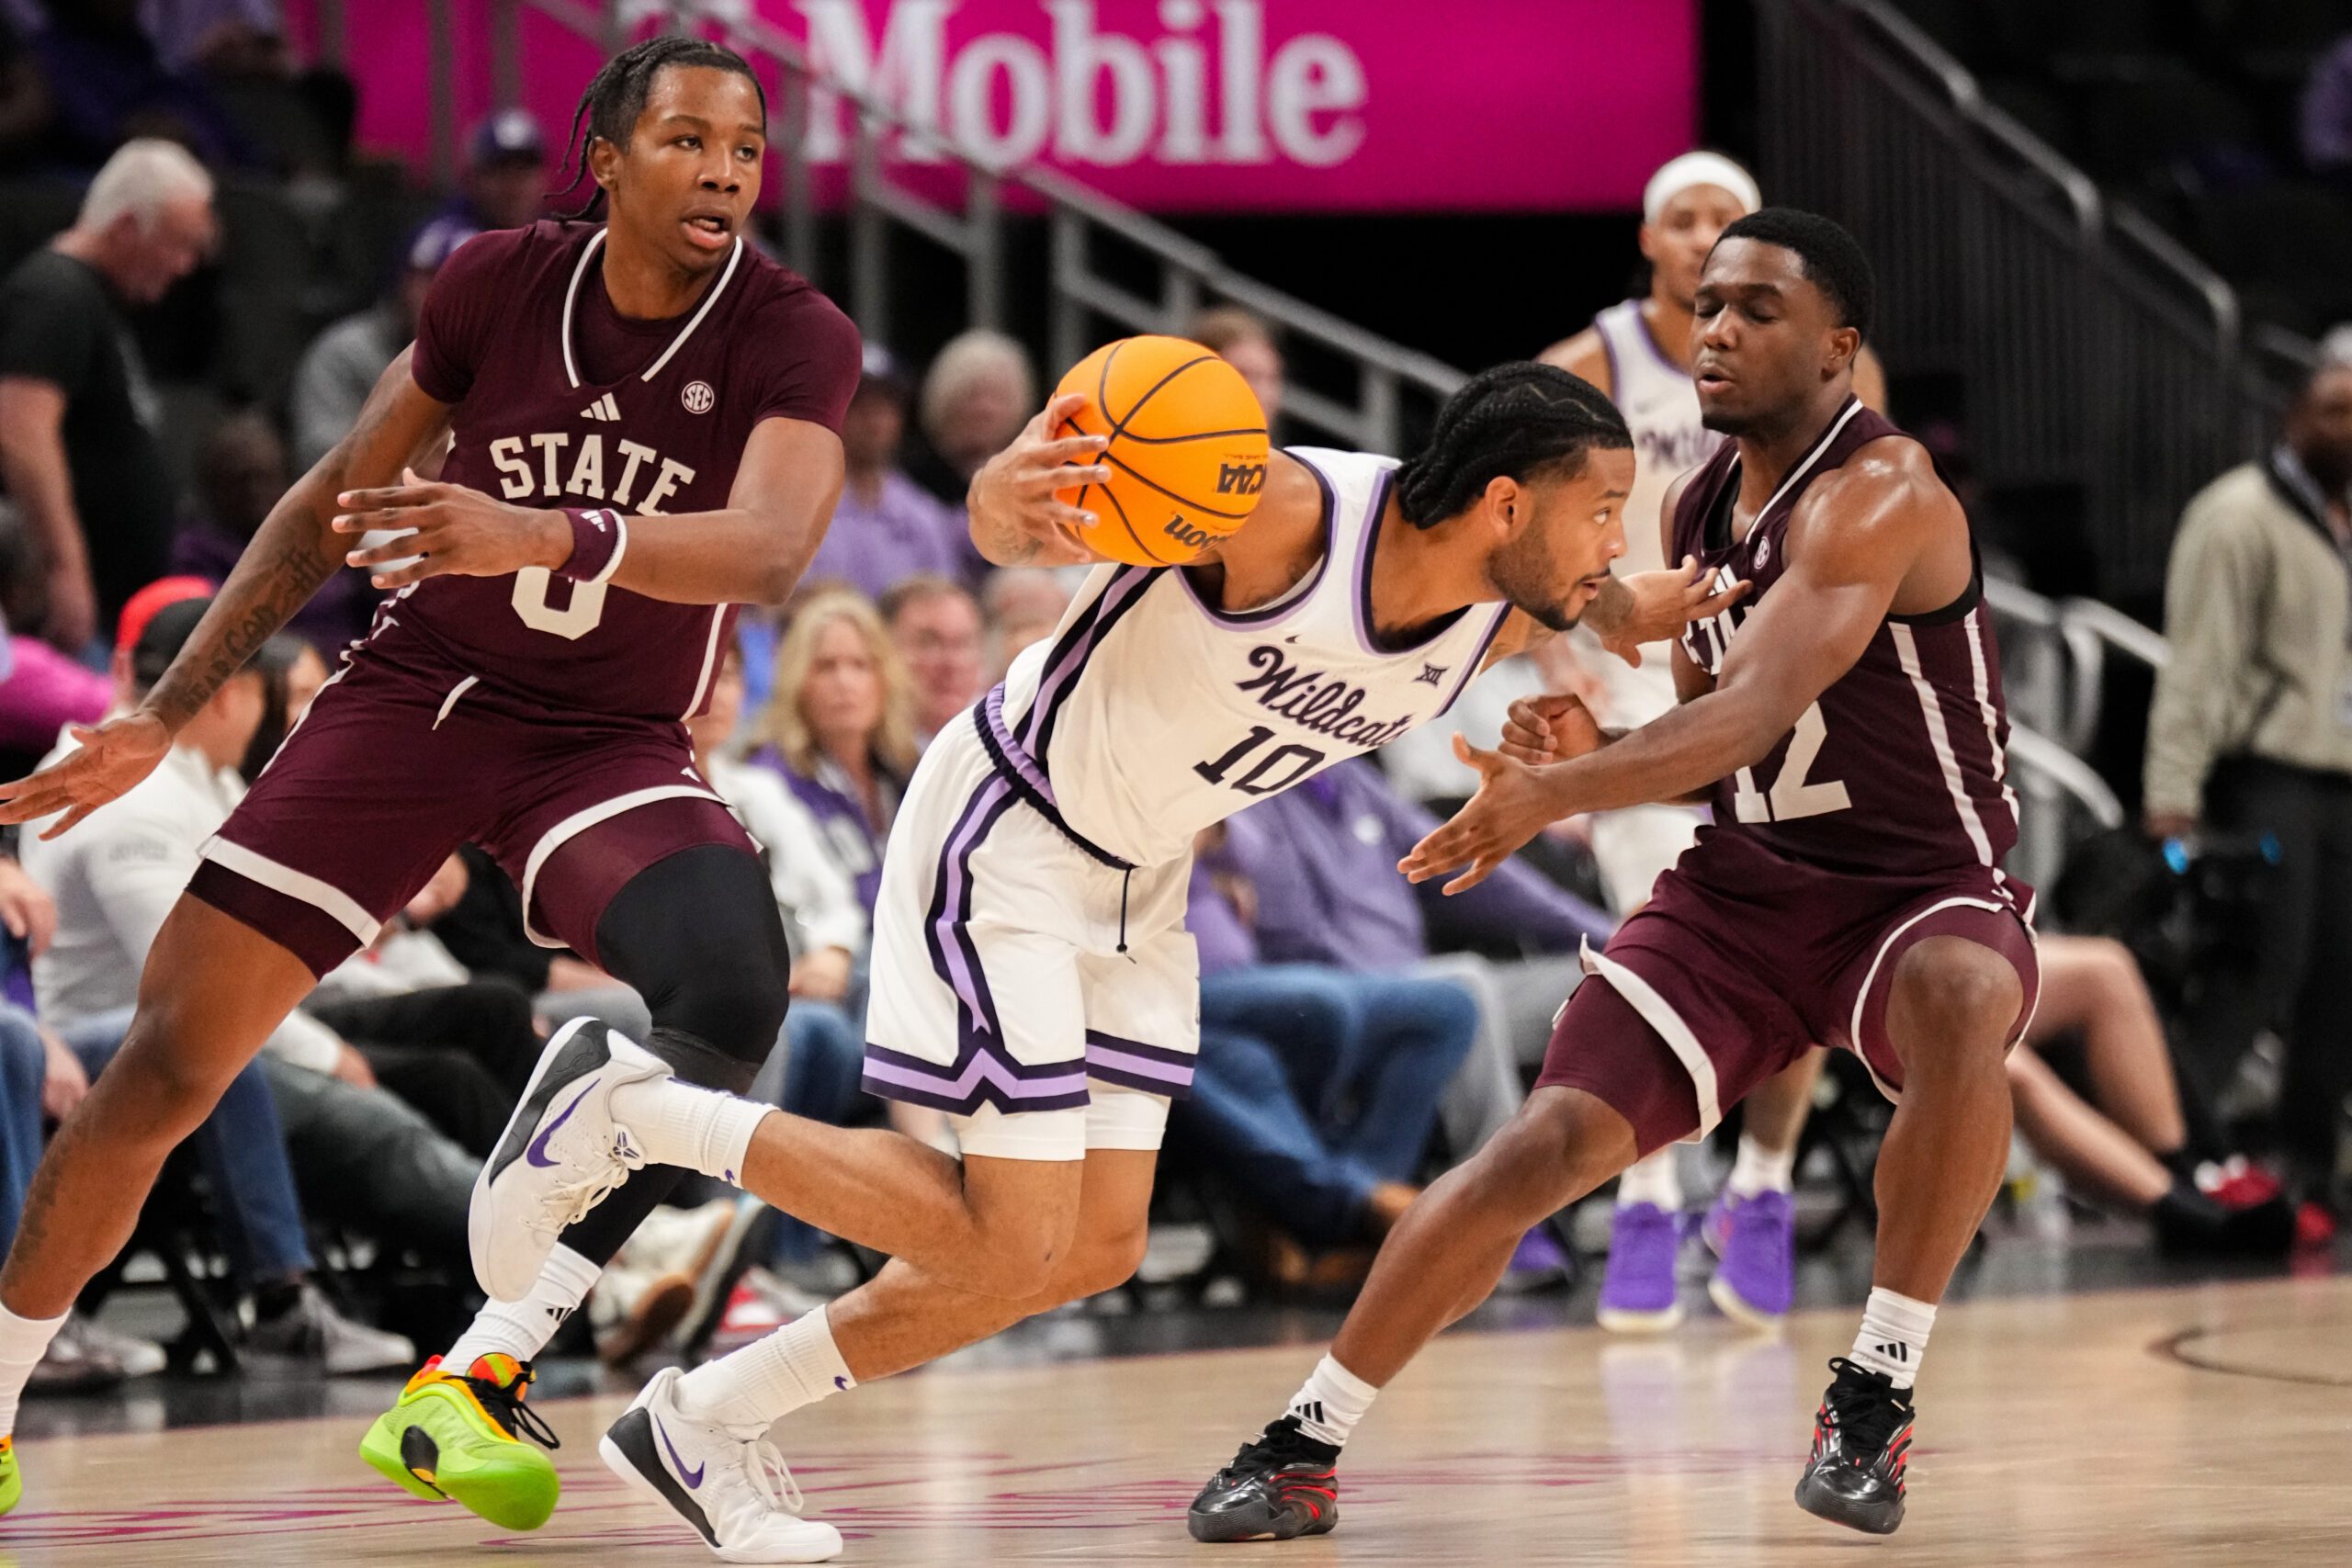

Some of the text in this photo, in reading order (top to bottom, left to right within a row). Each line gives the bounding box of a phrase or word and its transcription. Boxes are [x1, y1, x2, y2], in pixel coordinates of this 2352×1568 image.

[794, 0, 1369, 166] Mobile
[684, 382, 712, 412] SEC
[489, 433, 695, 517] STATE
[1216, 463, 1267, 495] CAA
[1193, 726, 1326, 795] 10
